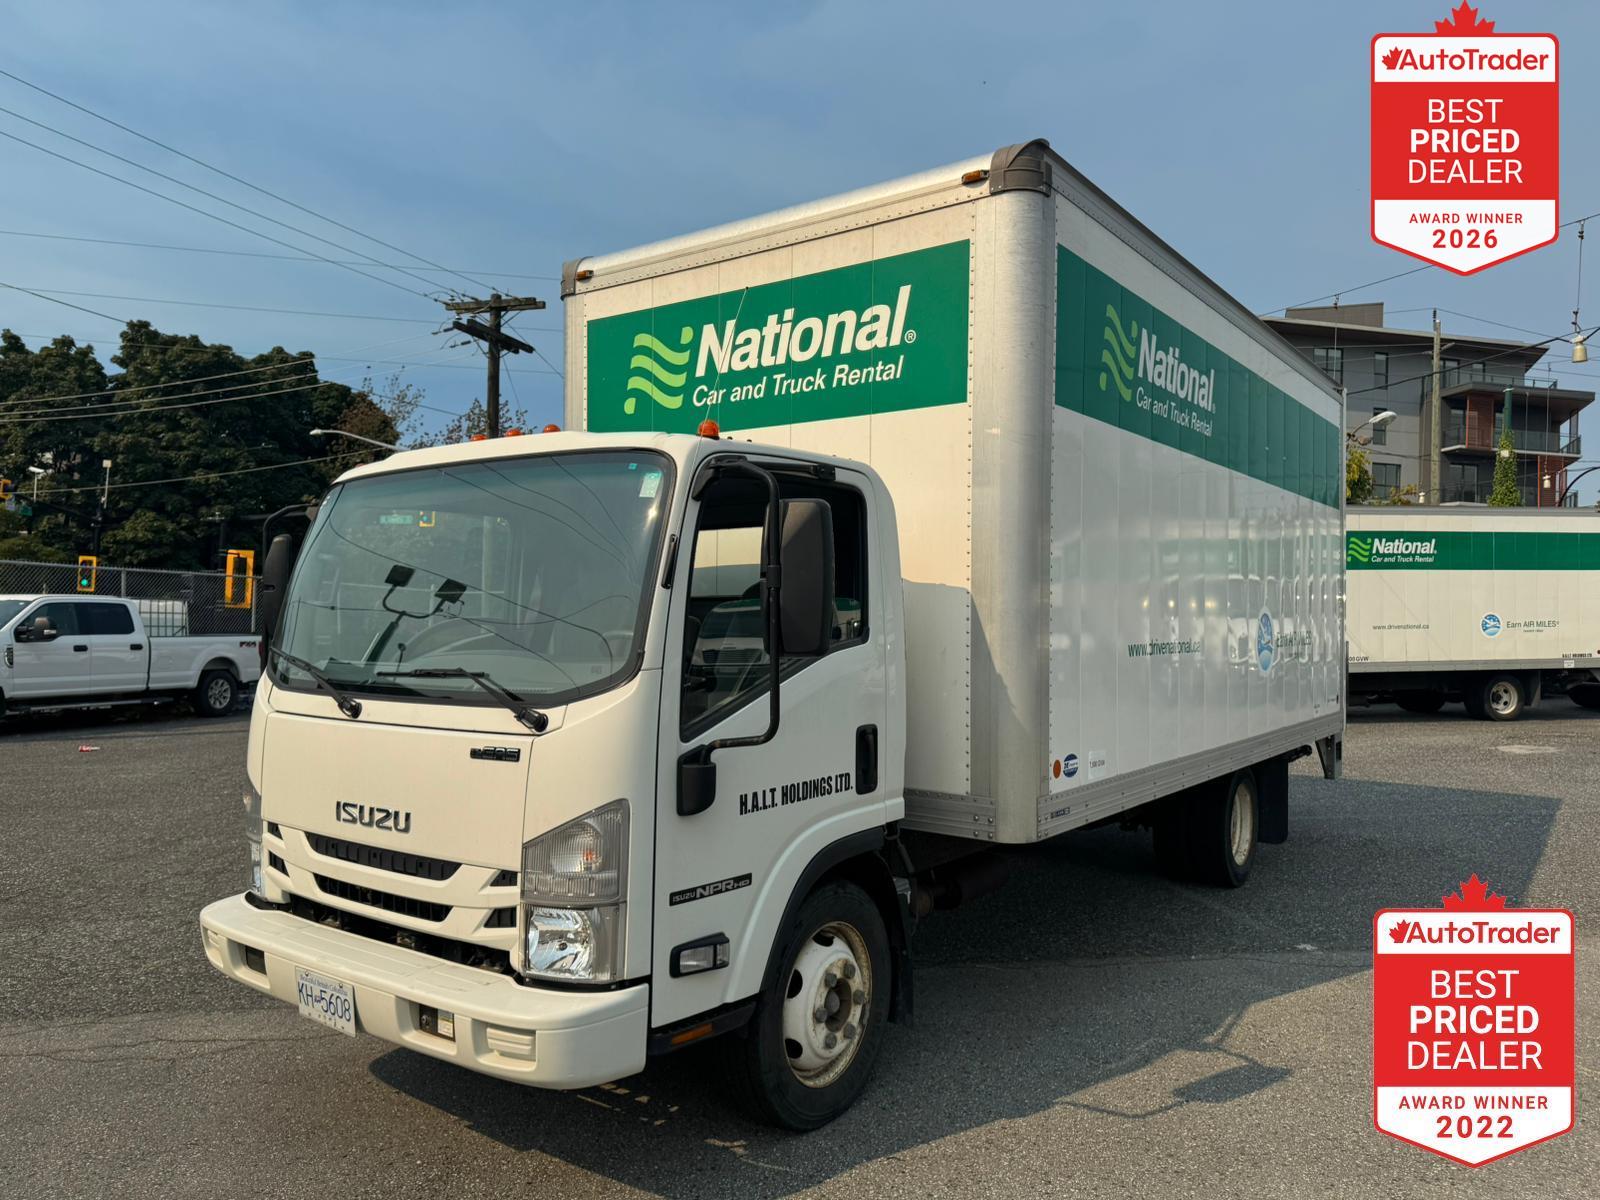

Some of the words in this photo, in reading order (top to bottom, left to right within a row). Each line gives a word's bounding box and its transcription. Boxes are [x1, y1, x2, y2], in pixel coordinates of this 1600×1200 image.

[692, 385, 726, 408] Car
[730, 376, 765, 403] and
[772, 373, 827, 397] Truck
[834, 355, 904, 388] Rental
[1136, 386, 1152, 408] Car
[1153, 399, 1169, 418] and
[1170, 402, 1190, 428] Truck
[1190, 412, 1213, 437] Rental
[1523, 620, 1535, 628] AIR
[739, 787, 777, 815] H.A.L.T.
[781, 775, 833, 806] HOLDINGS
[834, 772, 854, 793] LTD.
[335, 800, 411, 834] ISUZU
[672, 890, 696, 903] ISUZU
[695, 879, 734, 899] NPR
